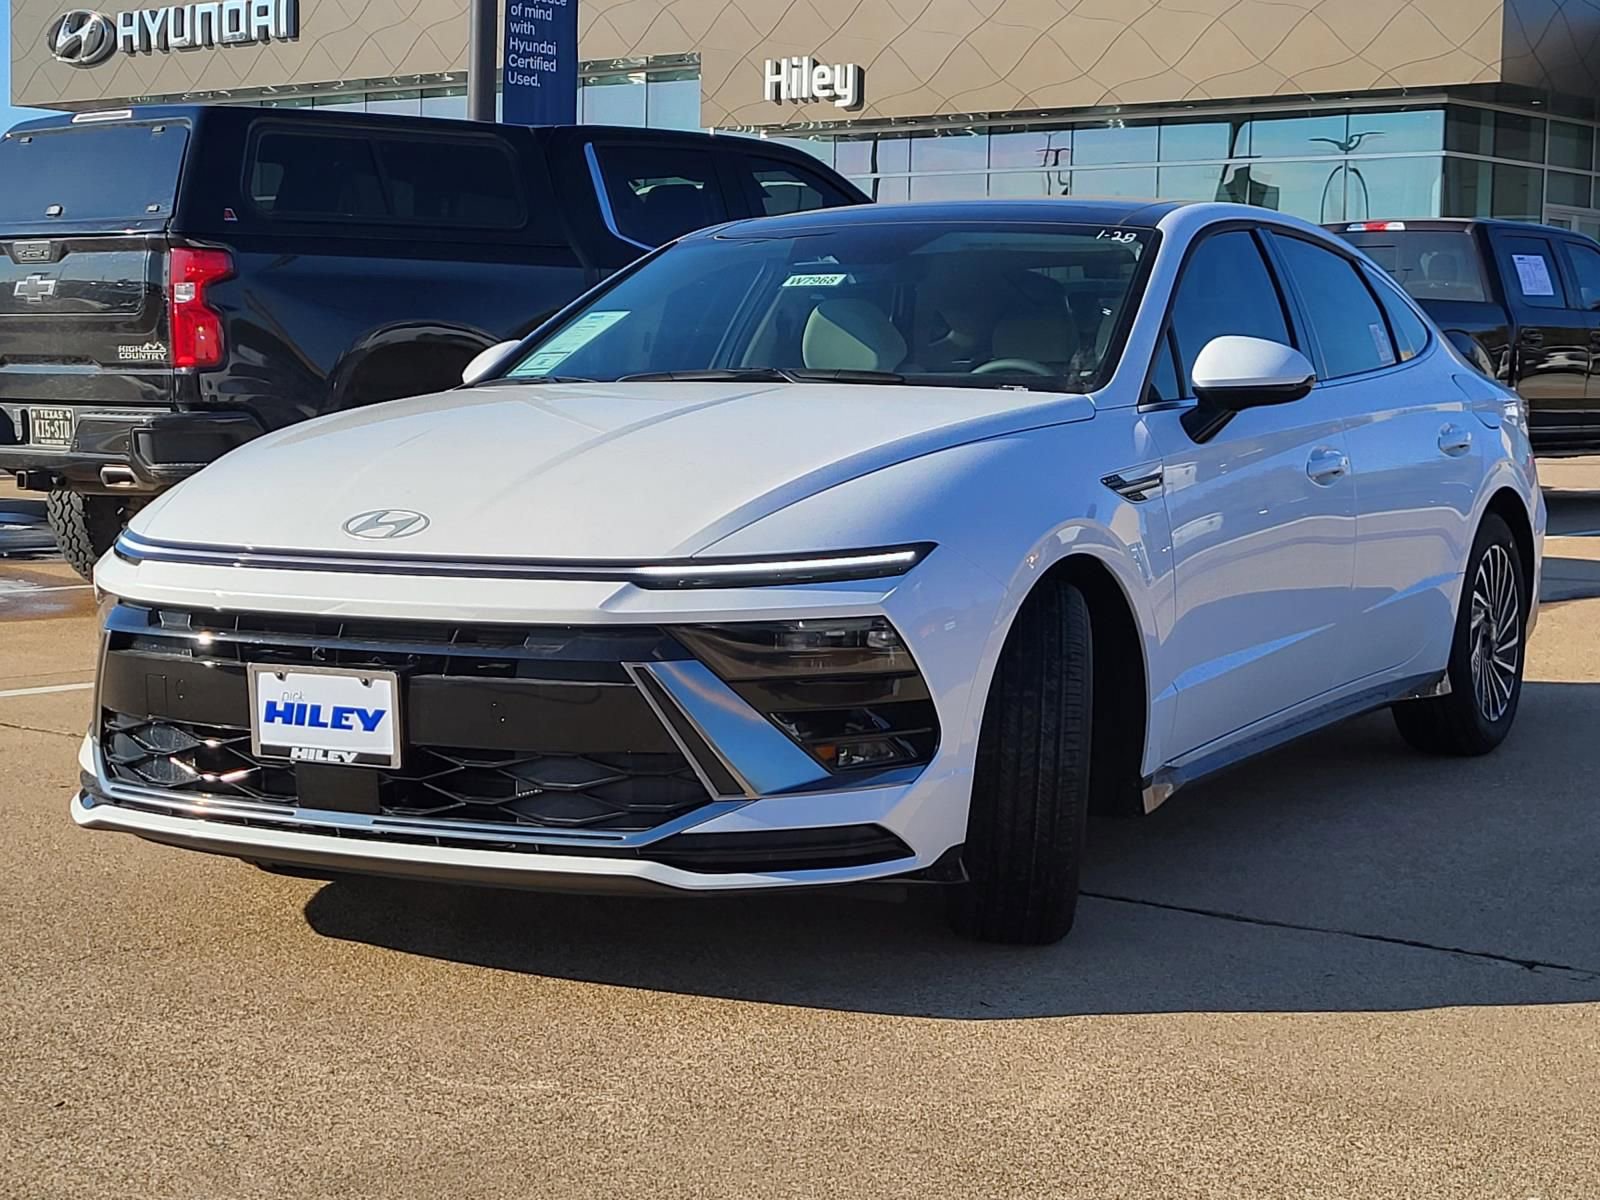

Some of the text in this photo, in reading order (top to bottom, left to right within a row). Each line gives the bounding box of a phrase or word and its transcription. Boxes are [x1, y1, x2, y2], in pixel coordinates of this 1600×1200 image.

[510, 3, 523, 16] of
[525, 5, 552, 21] mind
[116, 0, 290, 52] HYUNDAI
[510, 21, 535, 35] with
[509, 37, 556, 56] Hyundai
[508, 54, 556, 72] Certified
[508, 71, 540, 87] Used.
[765, 56, 859, 108] Hiley
[1096, 229, 1137, 243] 1-28
[119, 352, 167, 360] COUNTRY
[40, 410, 64, 419] TEXAS
[264, 701, 387, 732] HILEY
[290, 746, 359, 763] HILEY
